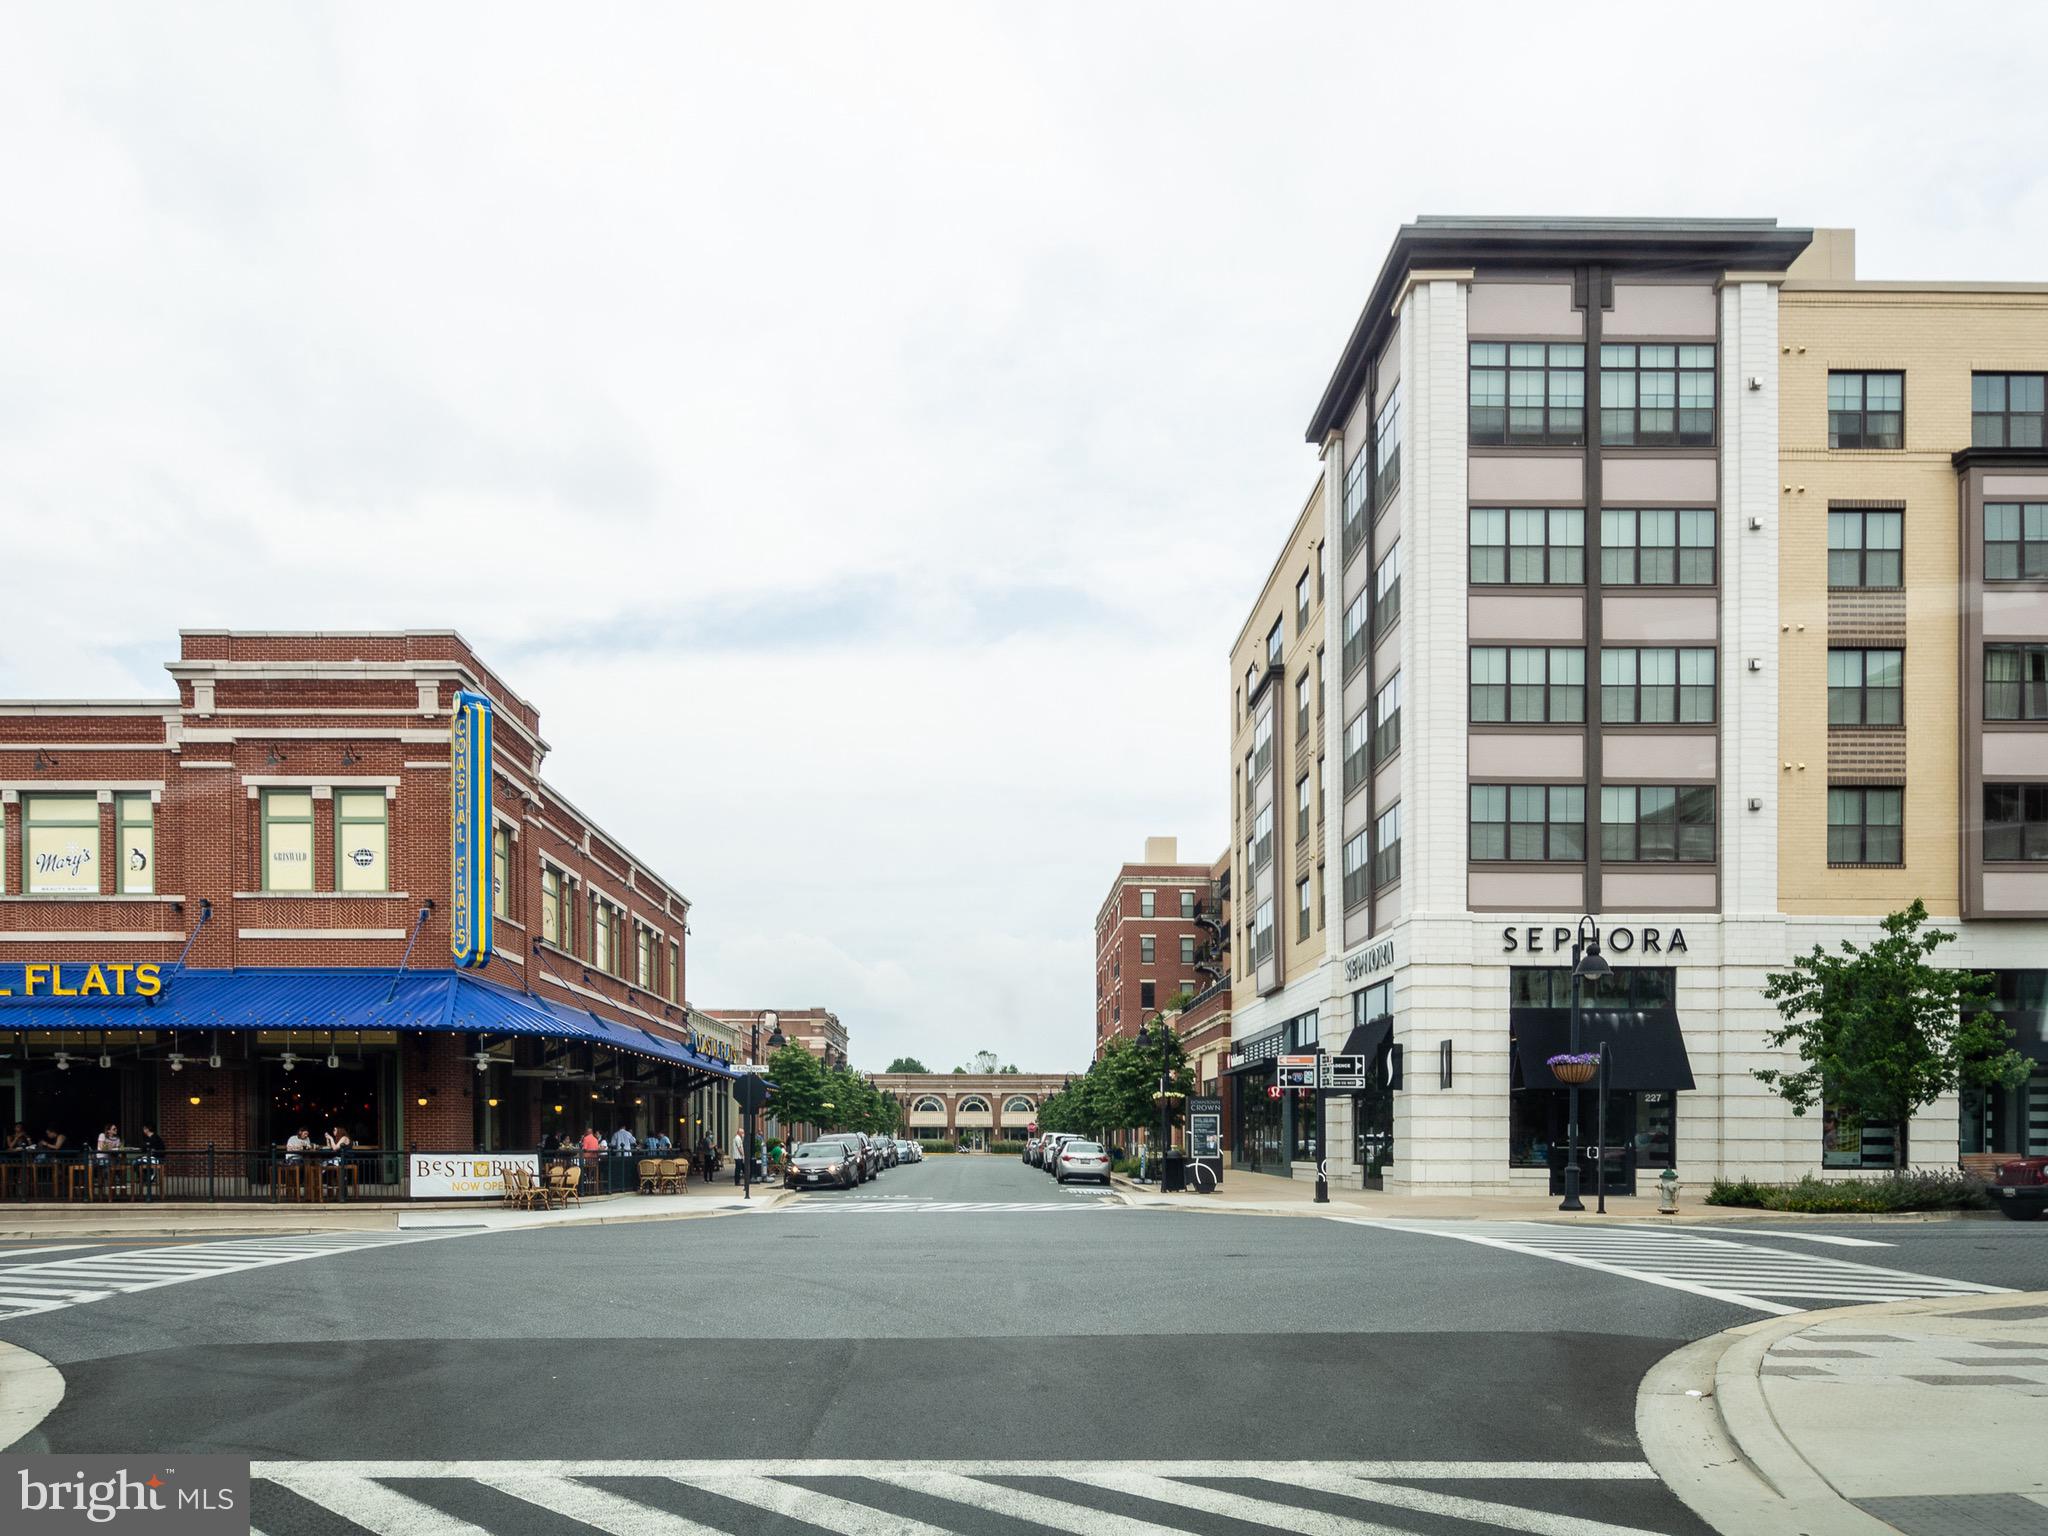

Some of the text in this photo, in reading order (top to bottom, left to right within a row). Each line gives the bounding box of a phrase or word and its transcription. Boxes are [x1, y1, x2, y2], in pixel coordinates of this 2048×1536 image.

[455, 719, 466, 945] COASTAL FLATS
[36, 848, 91, 877] Mary's
[1502, 926, 1688, 952] SEPHORA
[1344, 940, 1395, 982] SEPHORA
[25, 964, 161, 996] FLATS
[1190, 1104, 1221, 1112] CROWN
[1644, 1093, 1662, 1103] 227
[492, 1160, 535, 1178] BUNS
[452, 1182, 505, 1192] NOW OPE
